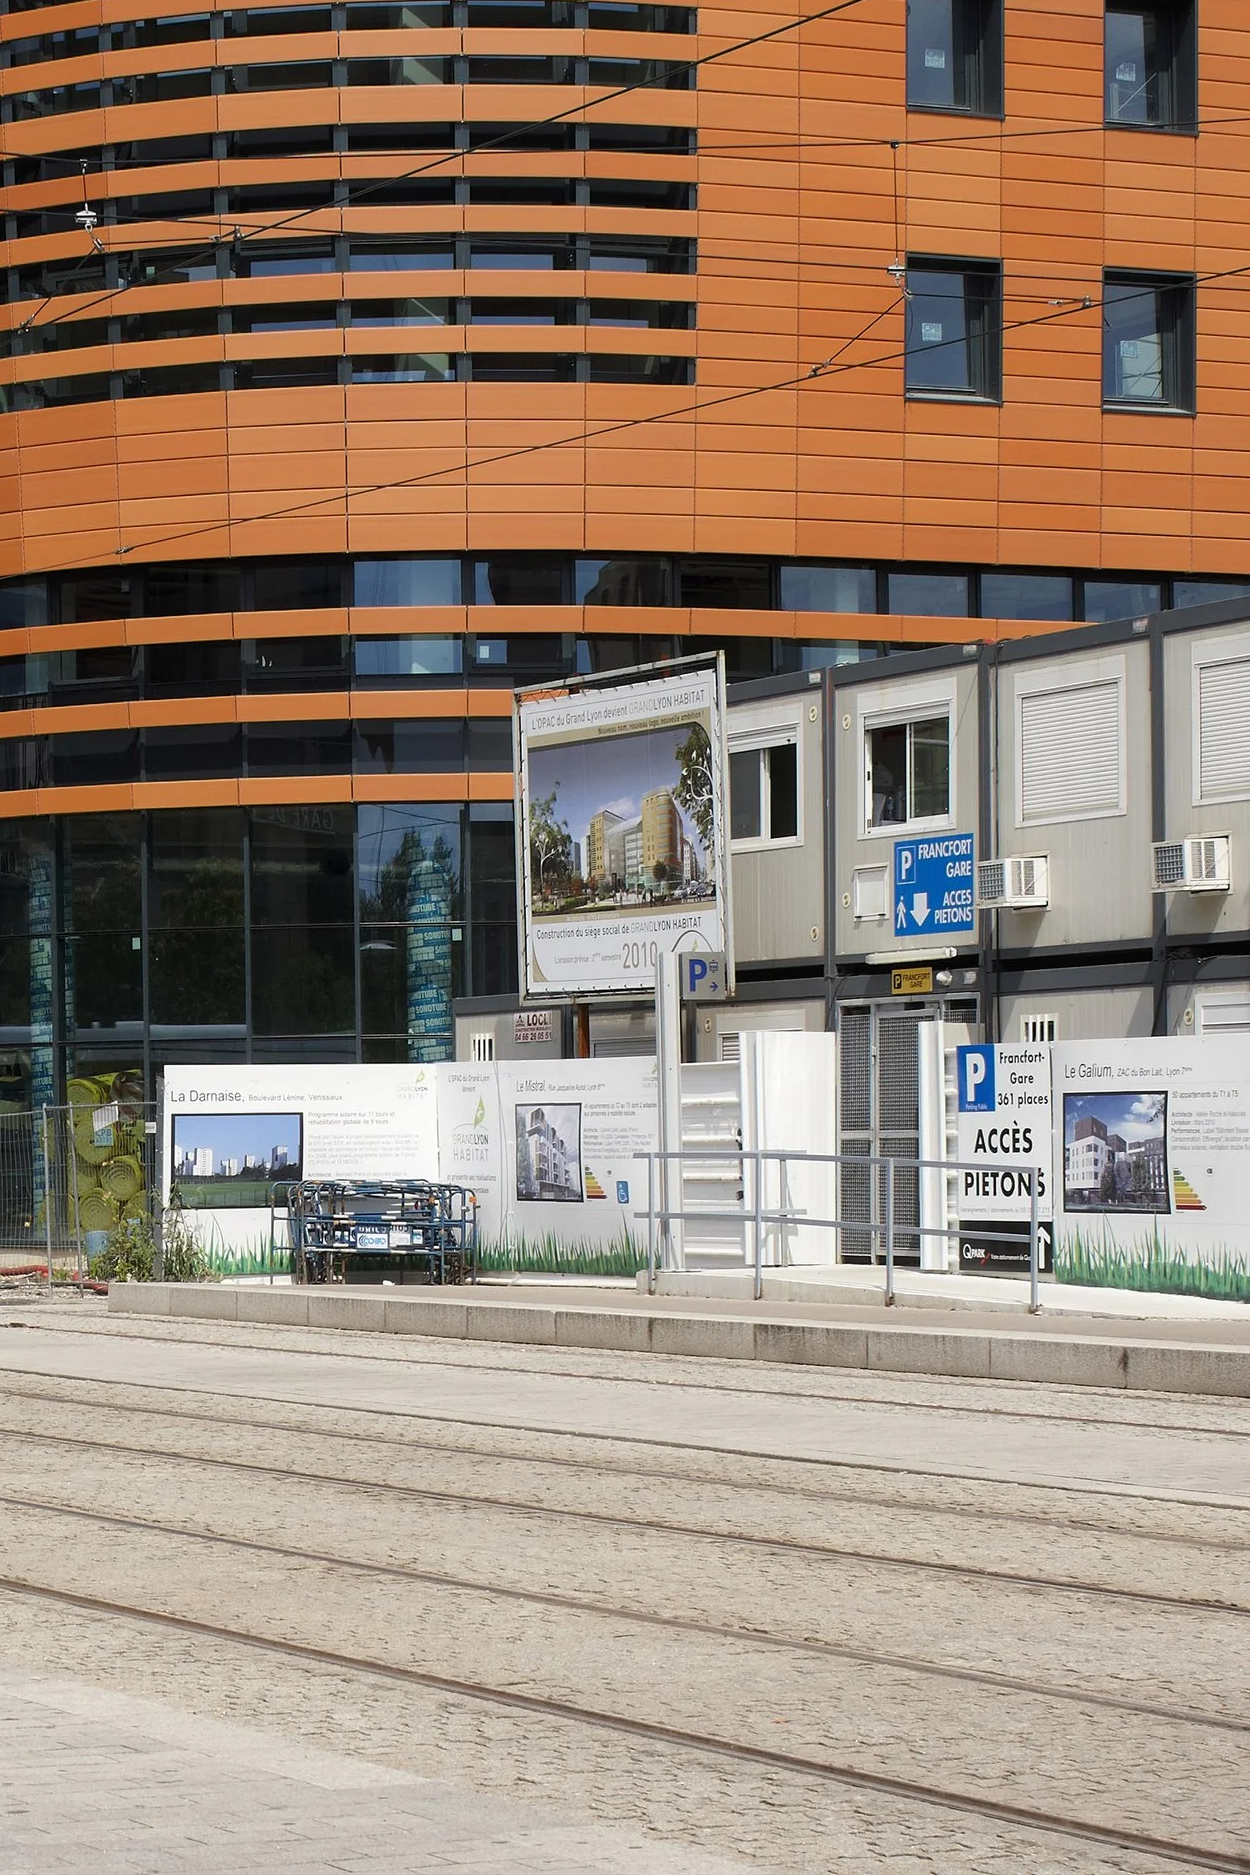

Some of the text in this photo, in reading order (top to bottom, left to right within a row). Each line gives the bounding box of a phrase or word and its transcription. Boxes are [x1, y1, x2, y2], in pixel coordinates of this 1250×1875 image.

[531, 715, 555, 731] L'OPAC
[556, 714, 565, 726] du
[565, 710, 586, 725] Grand
[586, 709, 603, 723] Lyon
[603, 704, 628, 719] devient
[673, 689, 705, 707] HABITAT
[918, 839, 972, 860] FRANCFORT
[901, 850, 912, 880] P
[946, 860, 972, 878] GARE
[943, 889, 972, 907] ACCES
[934, 906, 972, 925] PIETONS
[536, 928, 575, 940] Construction
[575, 927, 583, 938] du
[584, 926, 601, 939] siège
[602, 924, 621, 936] social
[621, 923, 630, 934] de
[672, 916, 702, 929] HABITAT
[622, 940, 657, 970] 2010
[688, 959, 707, 992] P
[903, 972, 931, 981] FRANCFORT
[910, 981, 923, 989] GARE
[415, 1003, 447, 1014] SONOTUBE
[999, 1050, 1045, 1064] Francfort-
[966, 1052, 986, 1102] P
[1010, 1072, 1034, 1084] Gare
[1064, 1064, 1076, 1078] Le
[1078, 1063, 1114, 1079] Galium,
[1117, 1068, 1130, 1077] ZAC
[1131, 1067, 1138, 1077] du
[1139, 1067, 1150, 1076] Bon
[1166, 1066, 1180, 1078] Lyon
[516, 1080, 524, 1092] Le
[1179, 1091, 1211, 1099] appartements
[170, 1090, 185, 1102] La
[189, 1089, 245, 1103] Darnaise,
[307, 1093, 343, 1101] Vénissieux
[997, 1091, 1049, 1109] 361 places
[308, 1111, 339, 1120] Programme
[974, 1120, 1033, 1154] ACCÈS
[453, 1148, 489, 1162] HABITAT
[964, 1170, 1046, 1197] PIETONS
